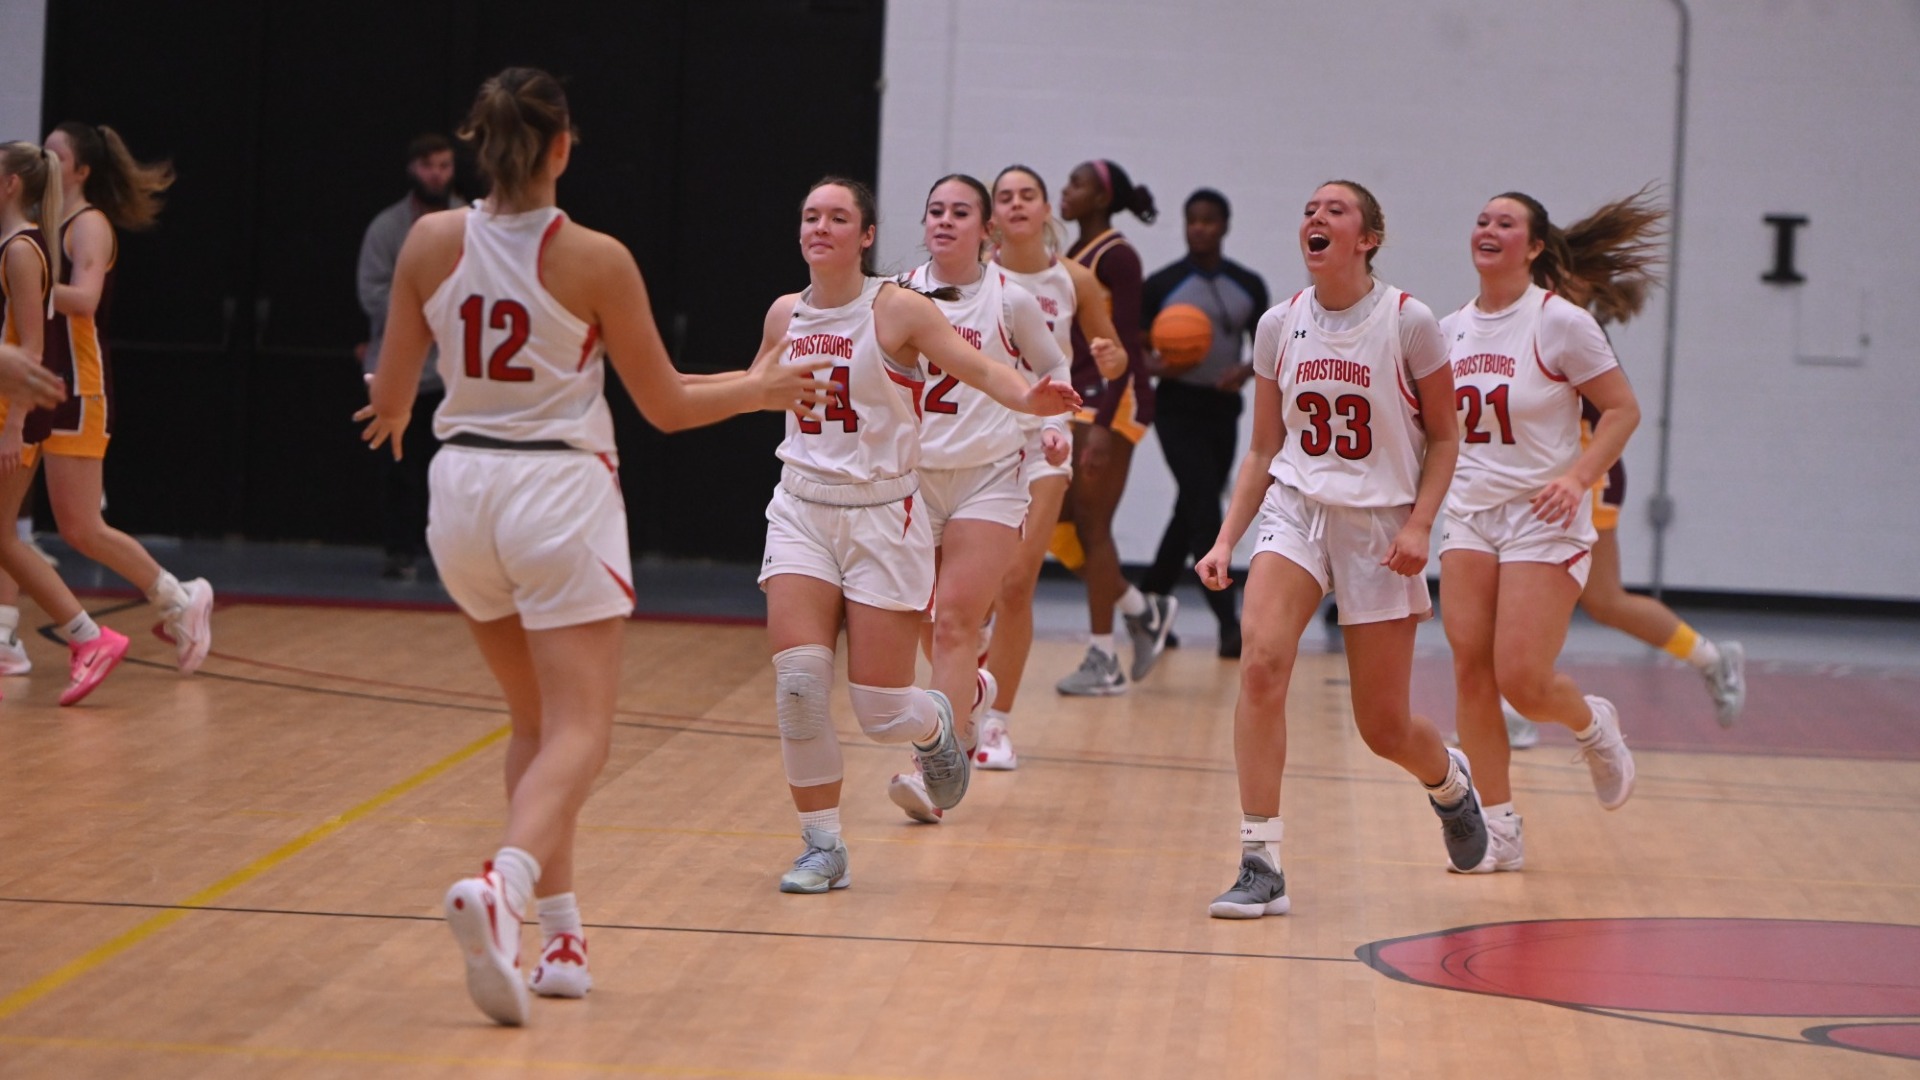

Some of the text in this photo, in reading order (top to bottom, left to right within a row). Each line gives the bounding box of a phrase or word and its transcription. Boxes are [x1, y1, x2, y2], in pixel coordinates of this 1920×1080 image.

[459, 293, 535, 382] 12
[789, 333, 853, 361] FROSTBURG
[1295, 358, 1370, 388] FROSTBURG
[1453, 353, 1516, 379] FROSTBURG
[1295, 391, 1373, 460] 33
[1454, 383, 1517, 445] 21
